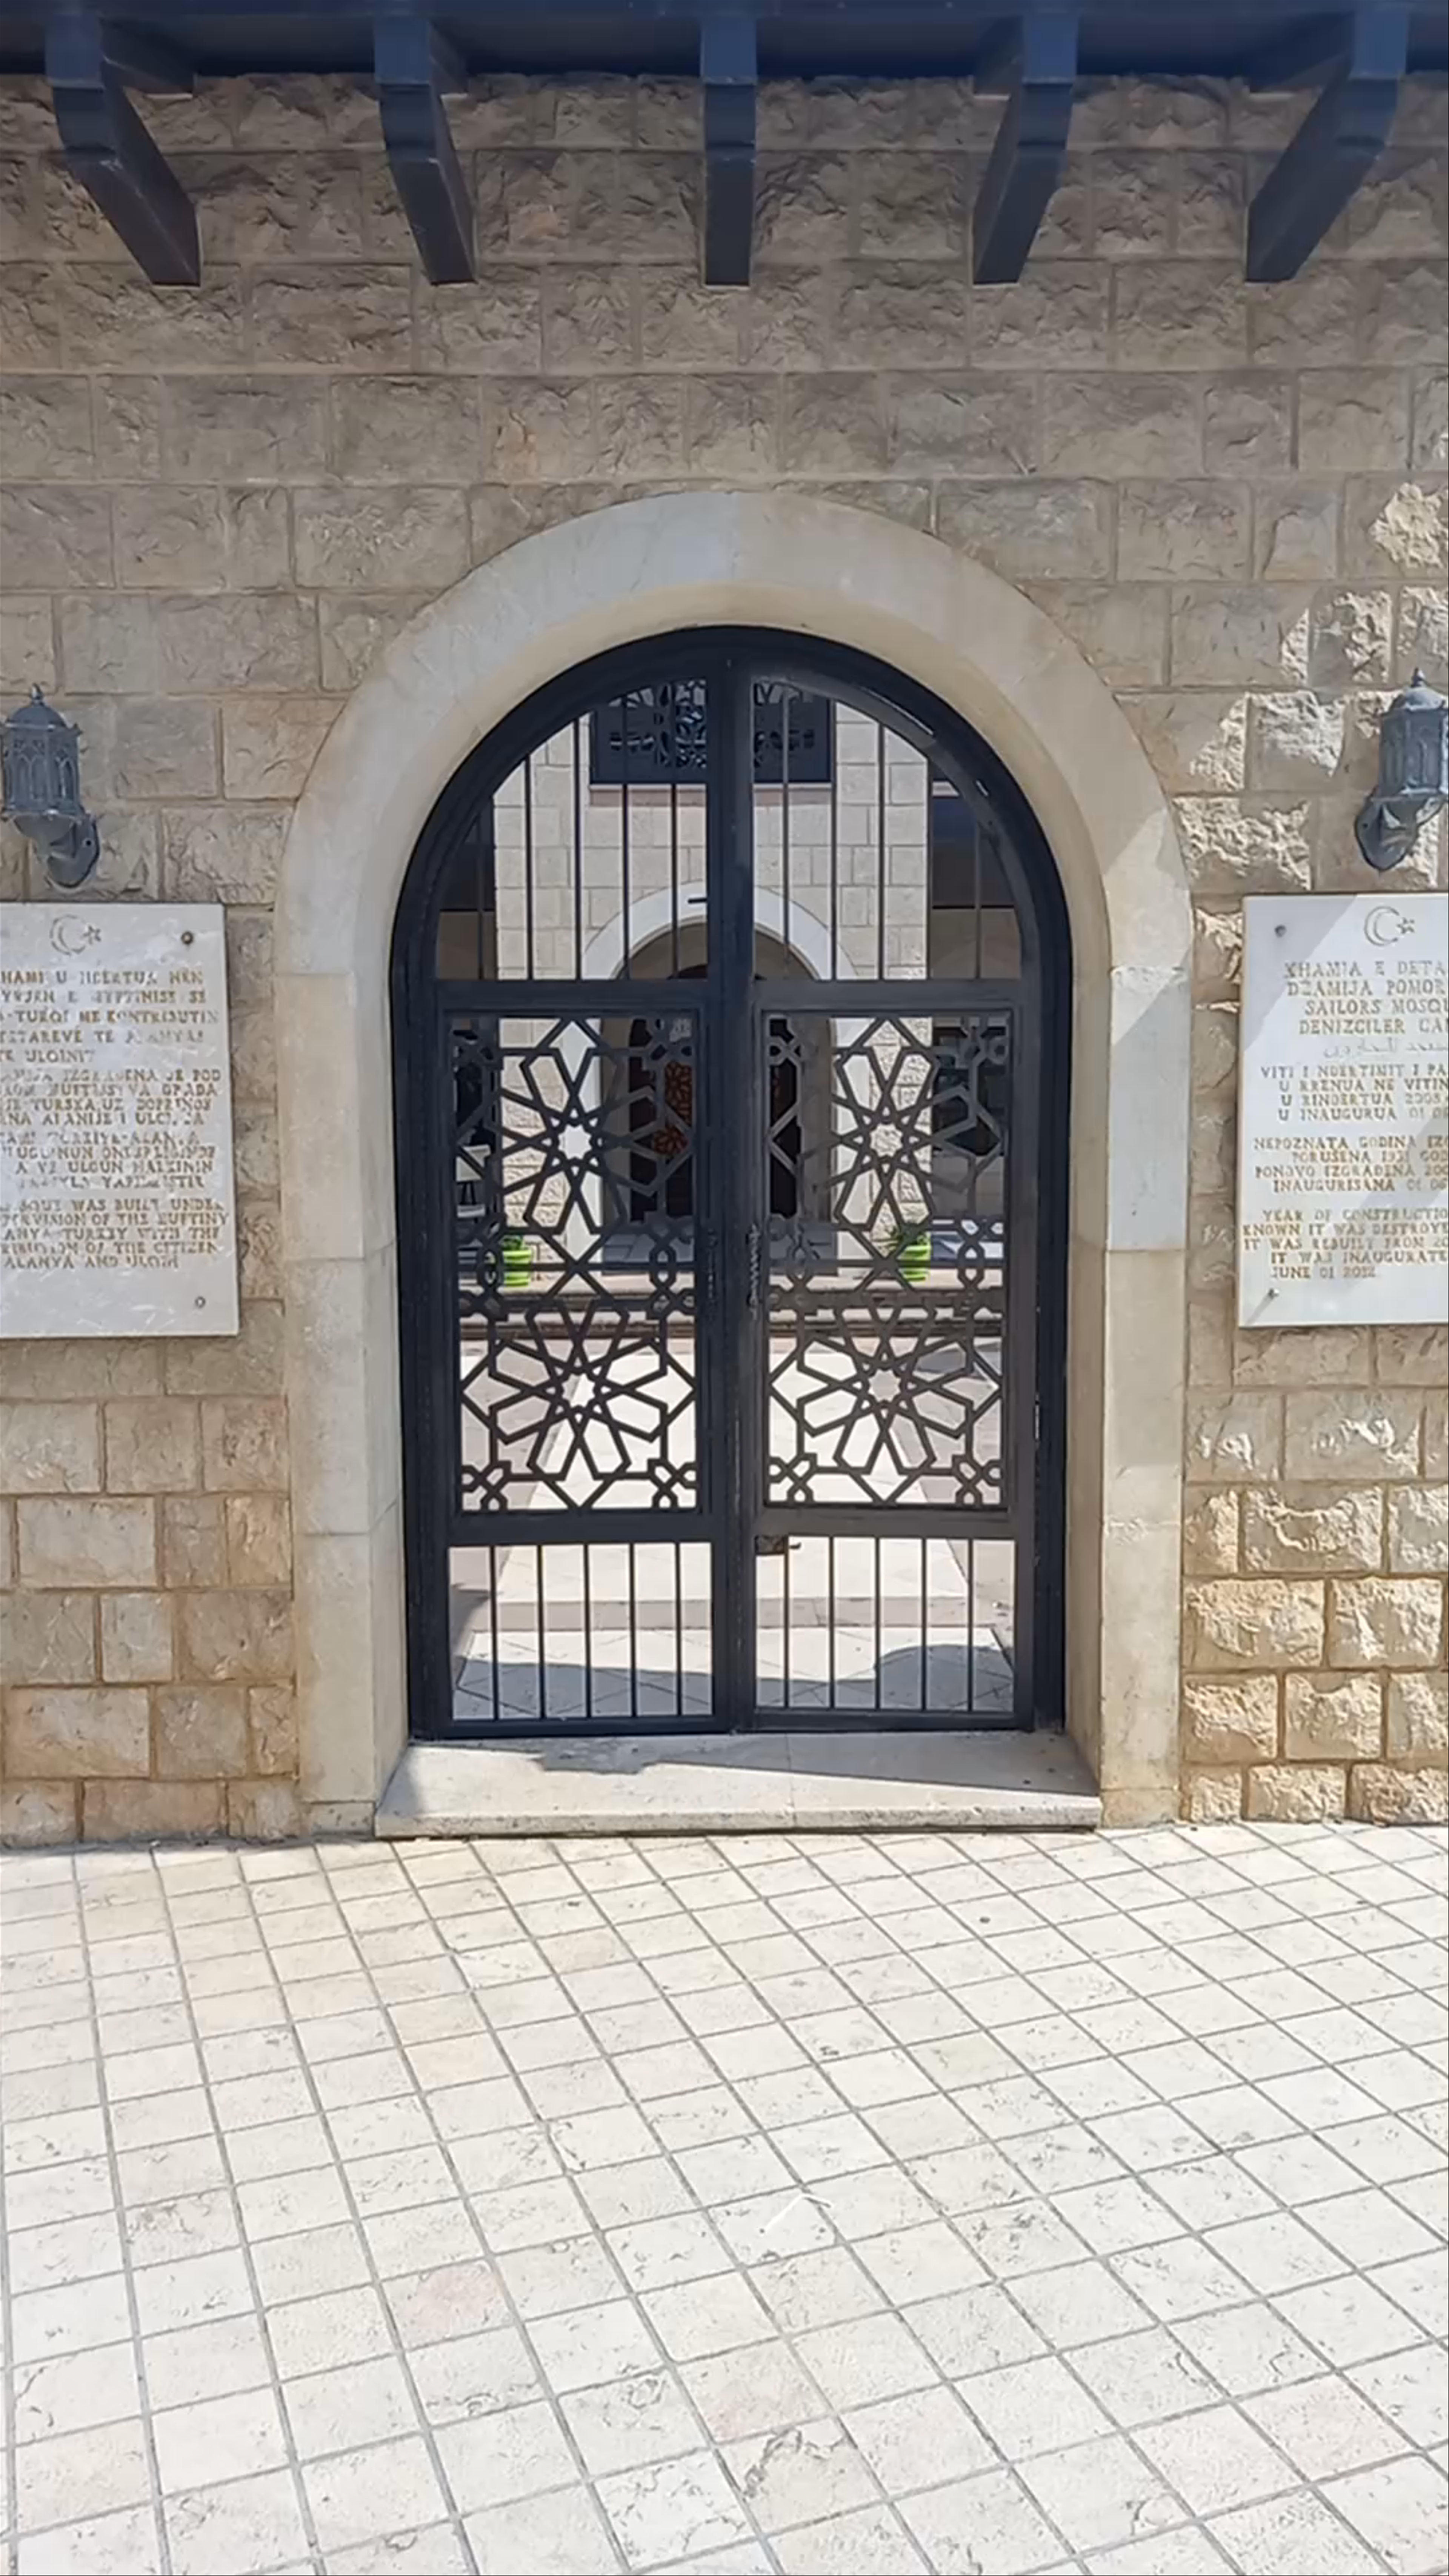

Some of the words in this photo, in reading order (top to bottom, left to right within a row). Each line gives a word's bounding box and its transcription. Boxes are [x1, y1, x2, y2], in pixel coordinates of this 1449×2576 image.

[1375, 960, 1384, 975] E
[1304, 999, 1382, 1015] SAILORS
[1300, 1018, 1406, 1035] DENIZCILER
[1261, 1066, 1294, 1078] VITI
[1279, 1080, 1290, 1092] U
[1281, 1095, 1292, 1106] U
[1278, 1108, 1289, 1121] U
[1300, 1107, 1397, 1121] INAUGURUA
[1254, 1137, 1349, 1149] NEPOZNATA
[1263, 1209, 1303, 1222] YEAR
[1244, 1238, 1261, 1251] IT
[1271, 1252, 1287, 1264] IT
